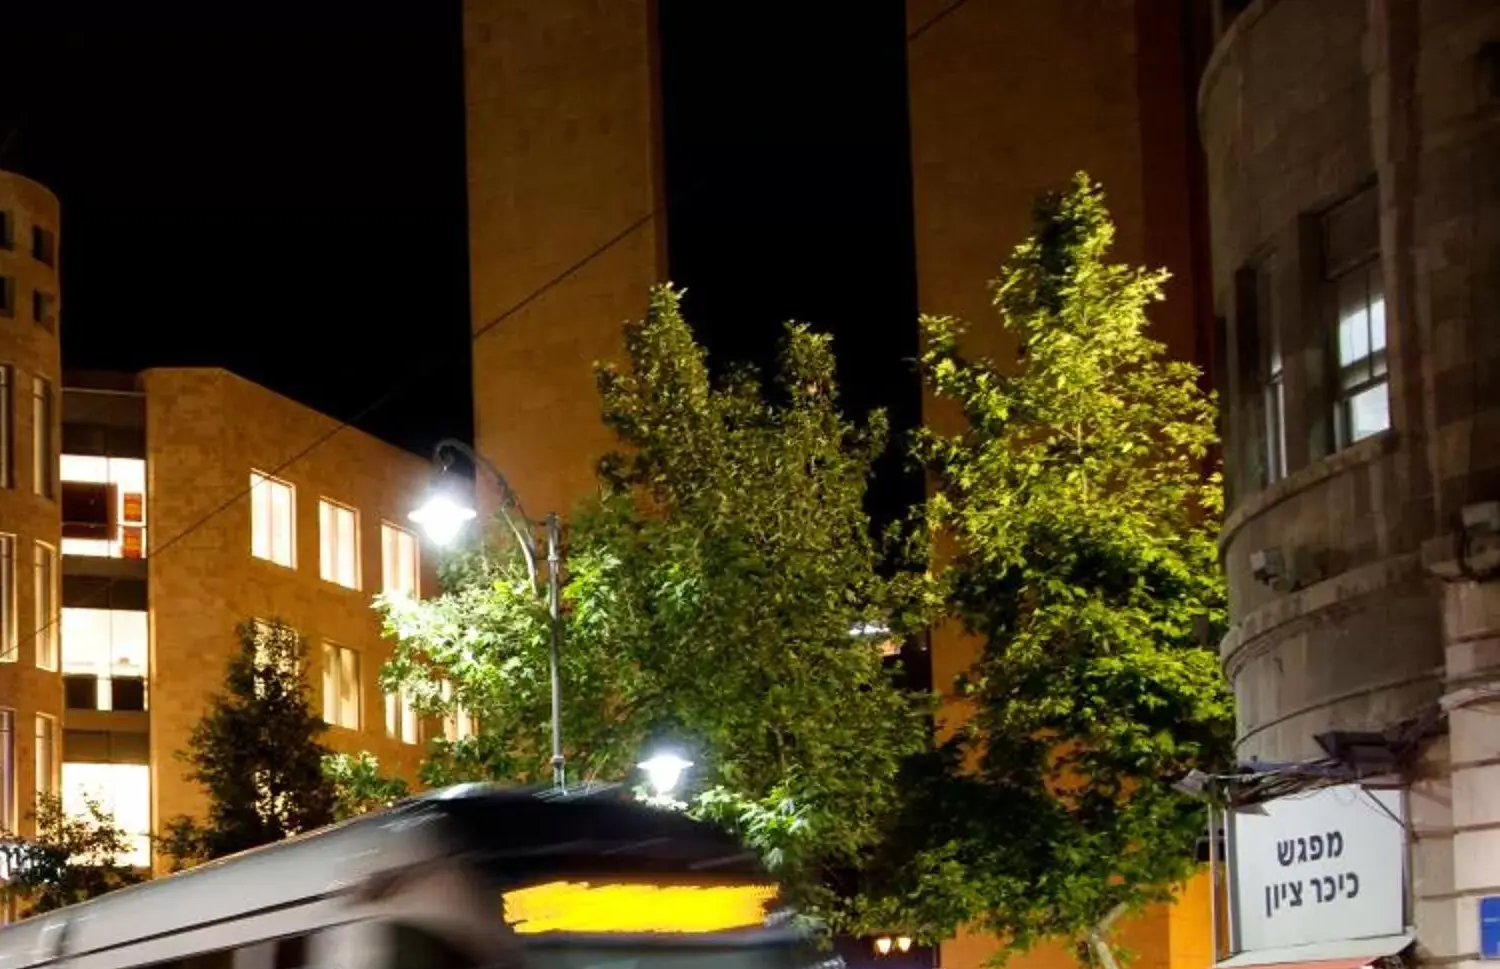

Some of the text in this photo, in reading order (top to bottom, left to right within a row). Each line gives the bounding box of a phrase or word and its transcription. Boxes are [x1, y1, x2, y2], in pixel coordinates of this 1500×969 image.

[1277, 830, 1344, 867] מפגש
[1265, 872, 1359, 918] כיכר ציון
